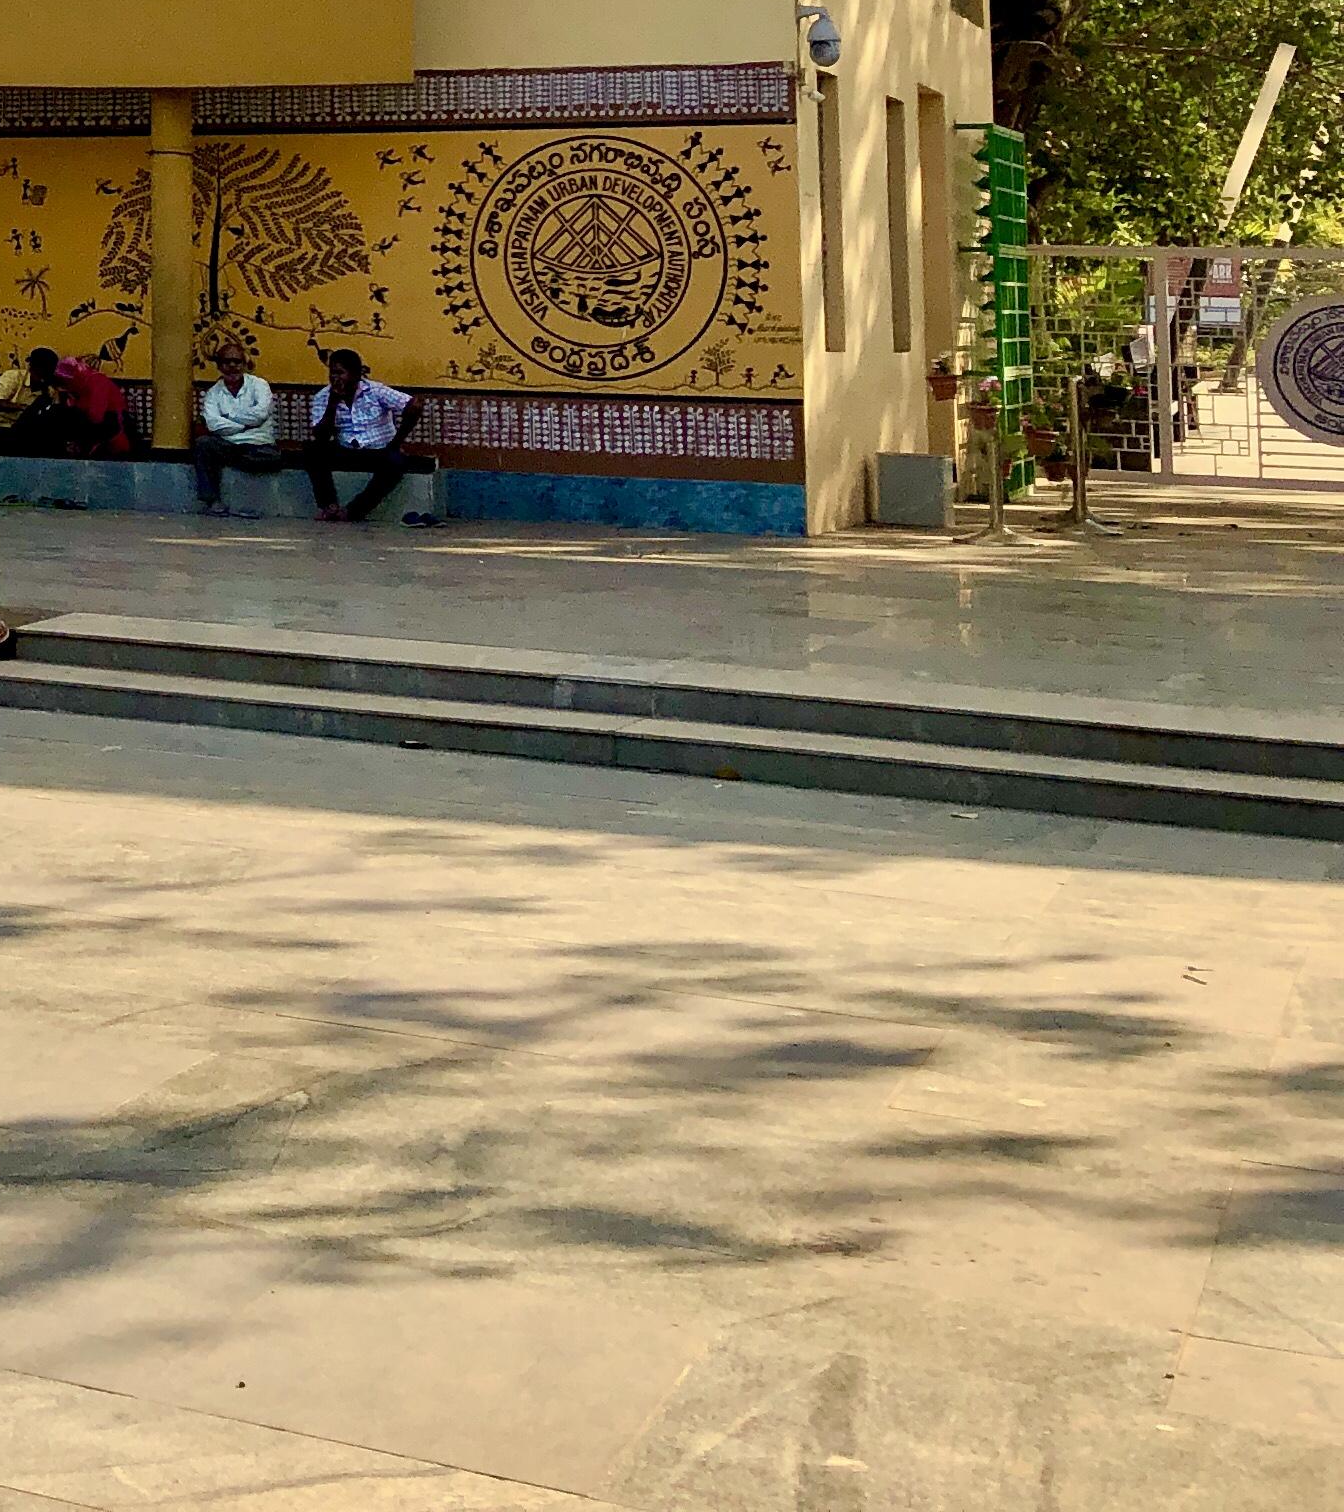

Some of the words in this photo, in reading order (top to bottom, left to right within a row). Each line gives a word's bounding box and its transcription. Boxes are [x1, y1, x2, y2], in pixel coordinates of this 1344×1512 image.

[510, 196, 551, 321] VISAKHAPATNAM
[546, 175, 599, 202] URBAN
[602, 175, 683, 247] DEVELOPMENT
